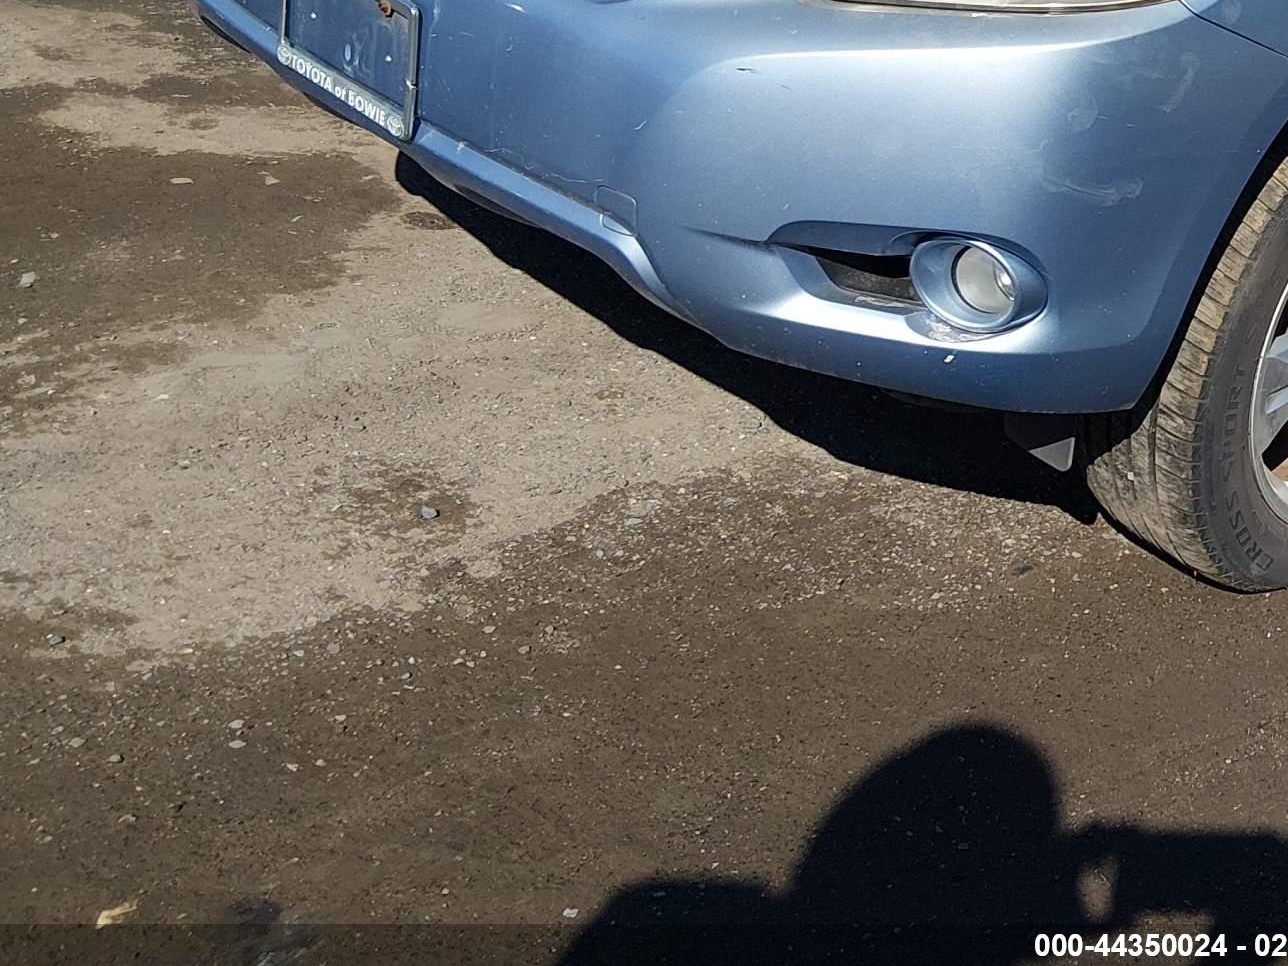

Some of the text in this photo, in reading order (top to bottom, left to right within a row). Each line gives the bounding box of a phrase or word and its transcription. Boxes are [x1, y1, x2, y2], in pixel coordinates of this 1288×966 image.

[290, 55, 386, 127] TOYOTA of BOWIE
[1222, 366, 1274, 572] CROSS SPORT
